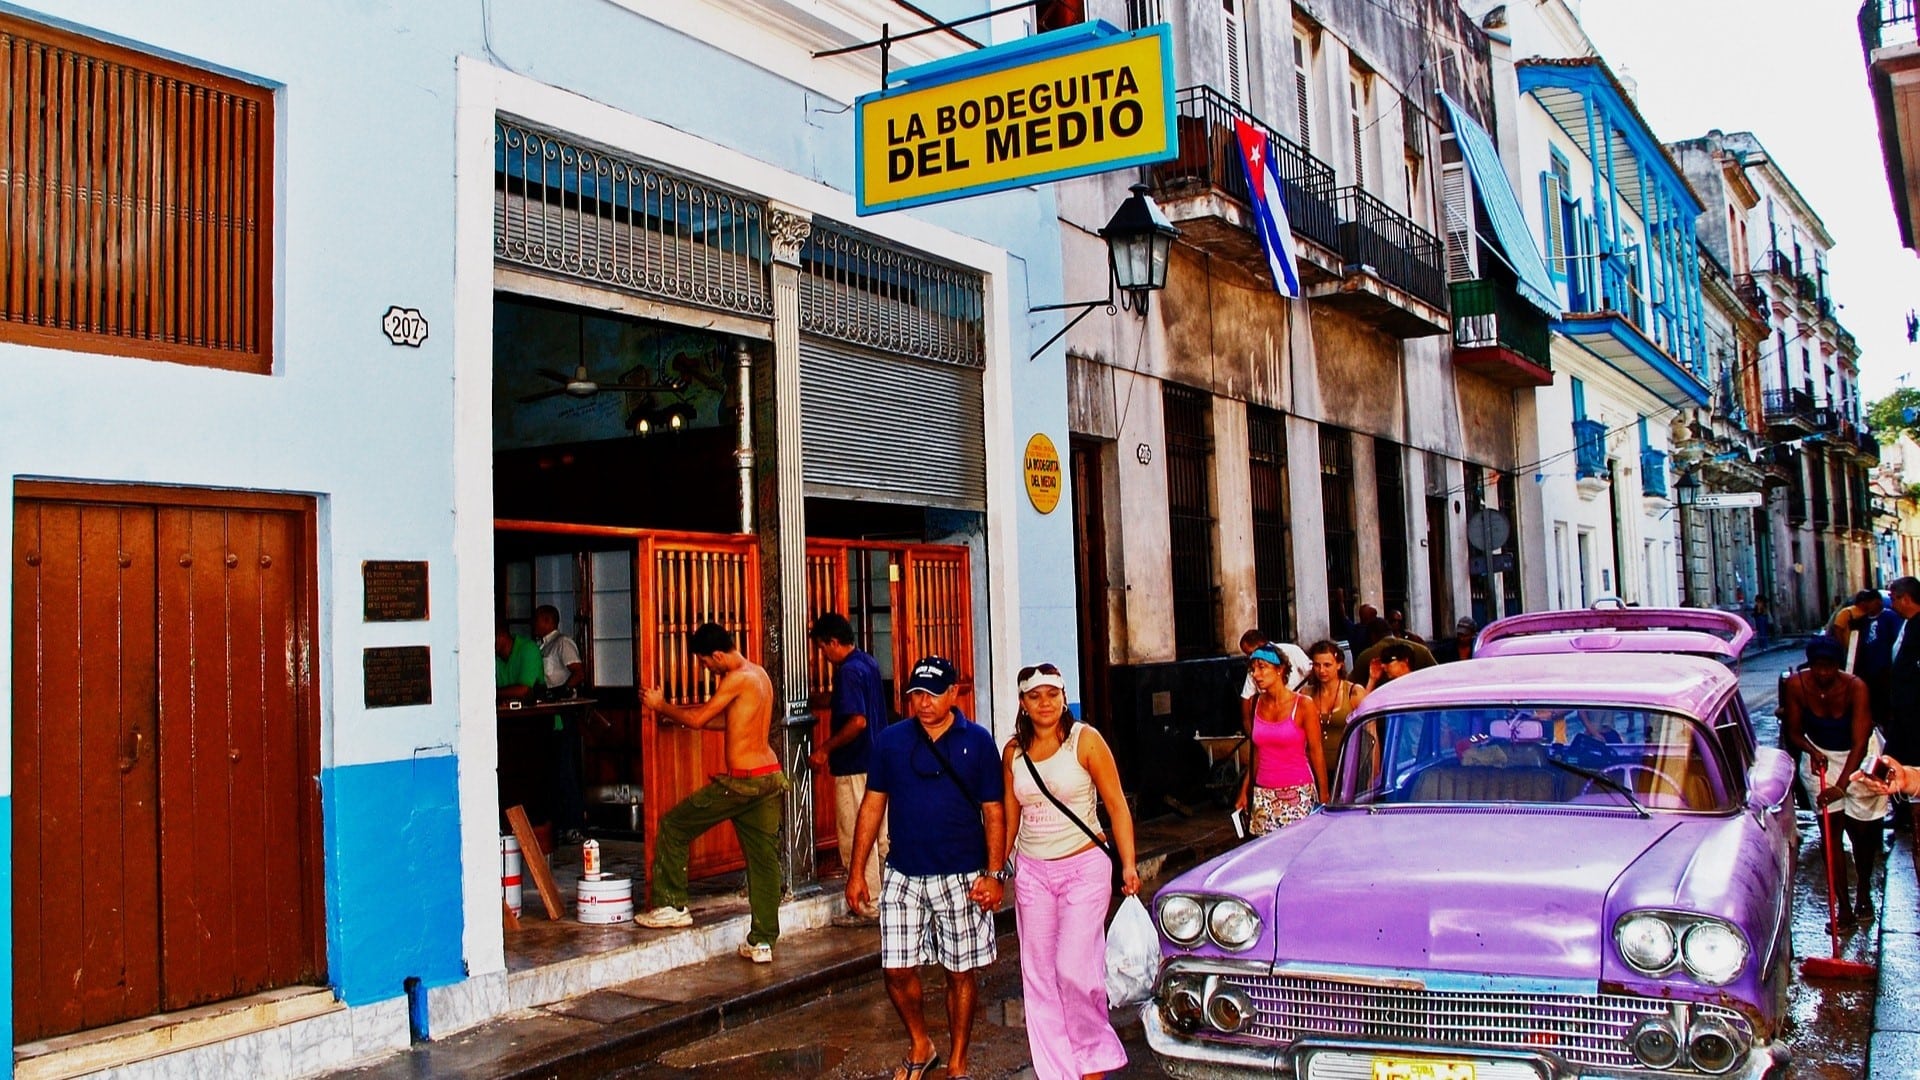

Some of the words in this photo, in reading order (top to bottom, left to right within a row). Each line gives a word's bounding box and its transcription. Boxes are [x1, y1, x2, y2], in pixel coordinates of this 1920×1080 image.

[888, 113, 926, 146] LA
[937, 65, 1139, 135] BODEGUITA
[888, 137, 970, 184] DEL
[985, 99, 1144, 164] MEDIO
[392, 316, 419, 339] 207
[1026, 458, 1032, 470] LA
[1031, 474, 1040, 487] DEL
[1040, 475, 1056, 488] MEDIO
